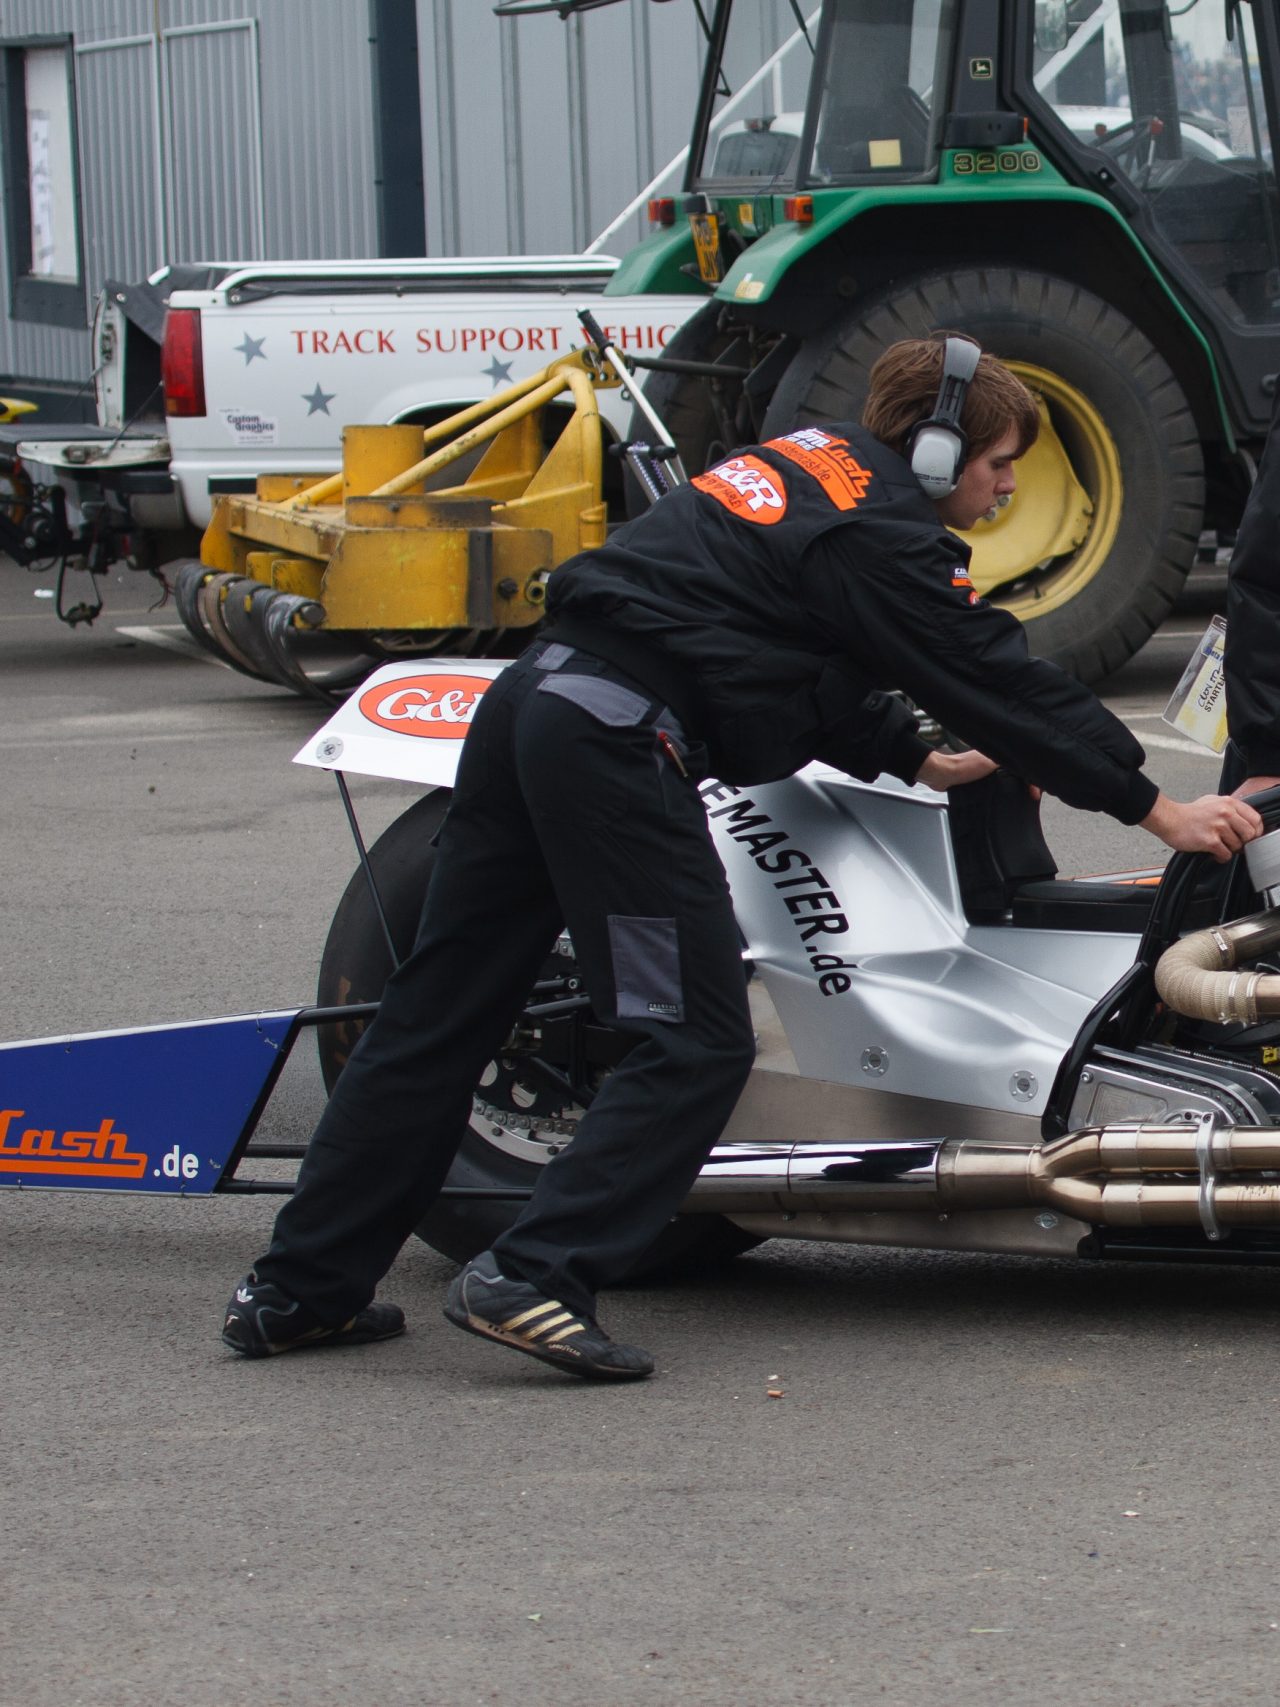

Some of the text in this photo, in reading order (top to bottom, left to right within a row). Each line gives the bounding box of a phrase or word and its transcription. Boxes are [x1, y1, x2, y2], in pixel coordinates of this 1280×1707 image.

[954, 151, 1041, 174] 3200
[290, 329, 397, 354] TRACK
[416, 326, 563, 353] SUPPORT
[709, 458, 785, 513] G&R
